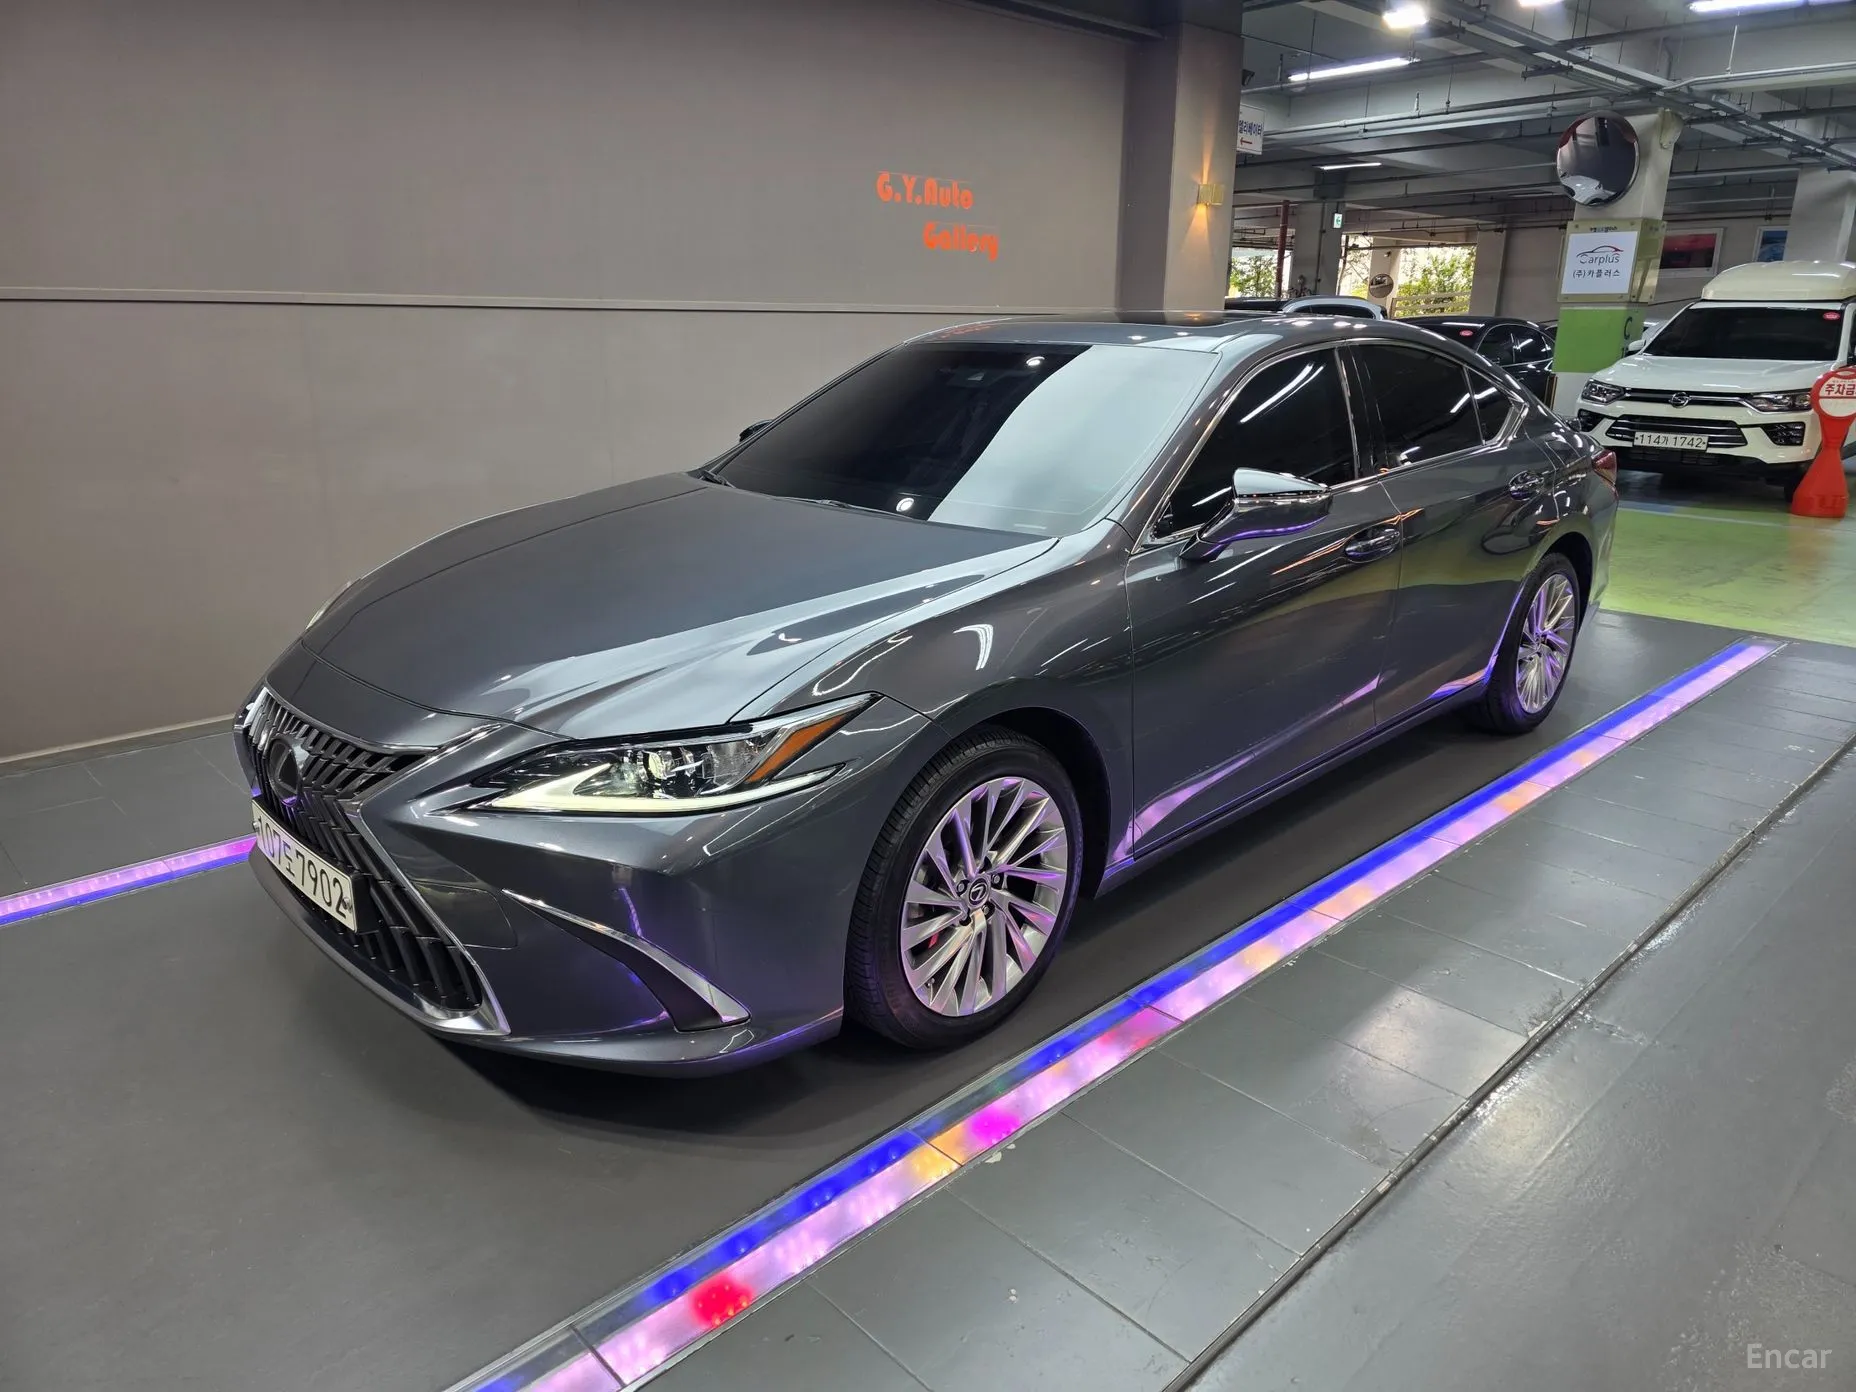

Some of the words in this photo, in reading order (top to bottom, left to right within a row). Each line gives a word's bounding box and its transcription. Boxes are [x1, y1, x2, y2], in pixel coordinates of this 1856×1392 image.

[924, 221, 998, 262] Gallery
[1579, 252, 1620, 266] Carplus
[1573, 269, 1620, 278] (주)카플러스
[1825, 384, 1856, 395] 주차금
[1673, 436, 1703, 448] 1742
[296, 850, 347, 919] 7902
